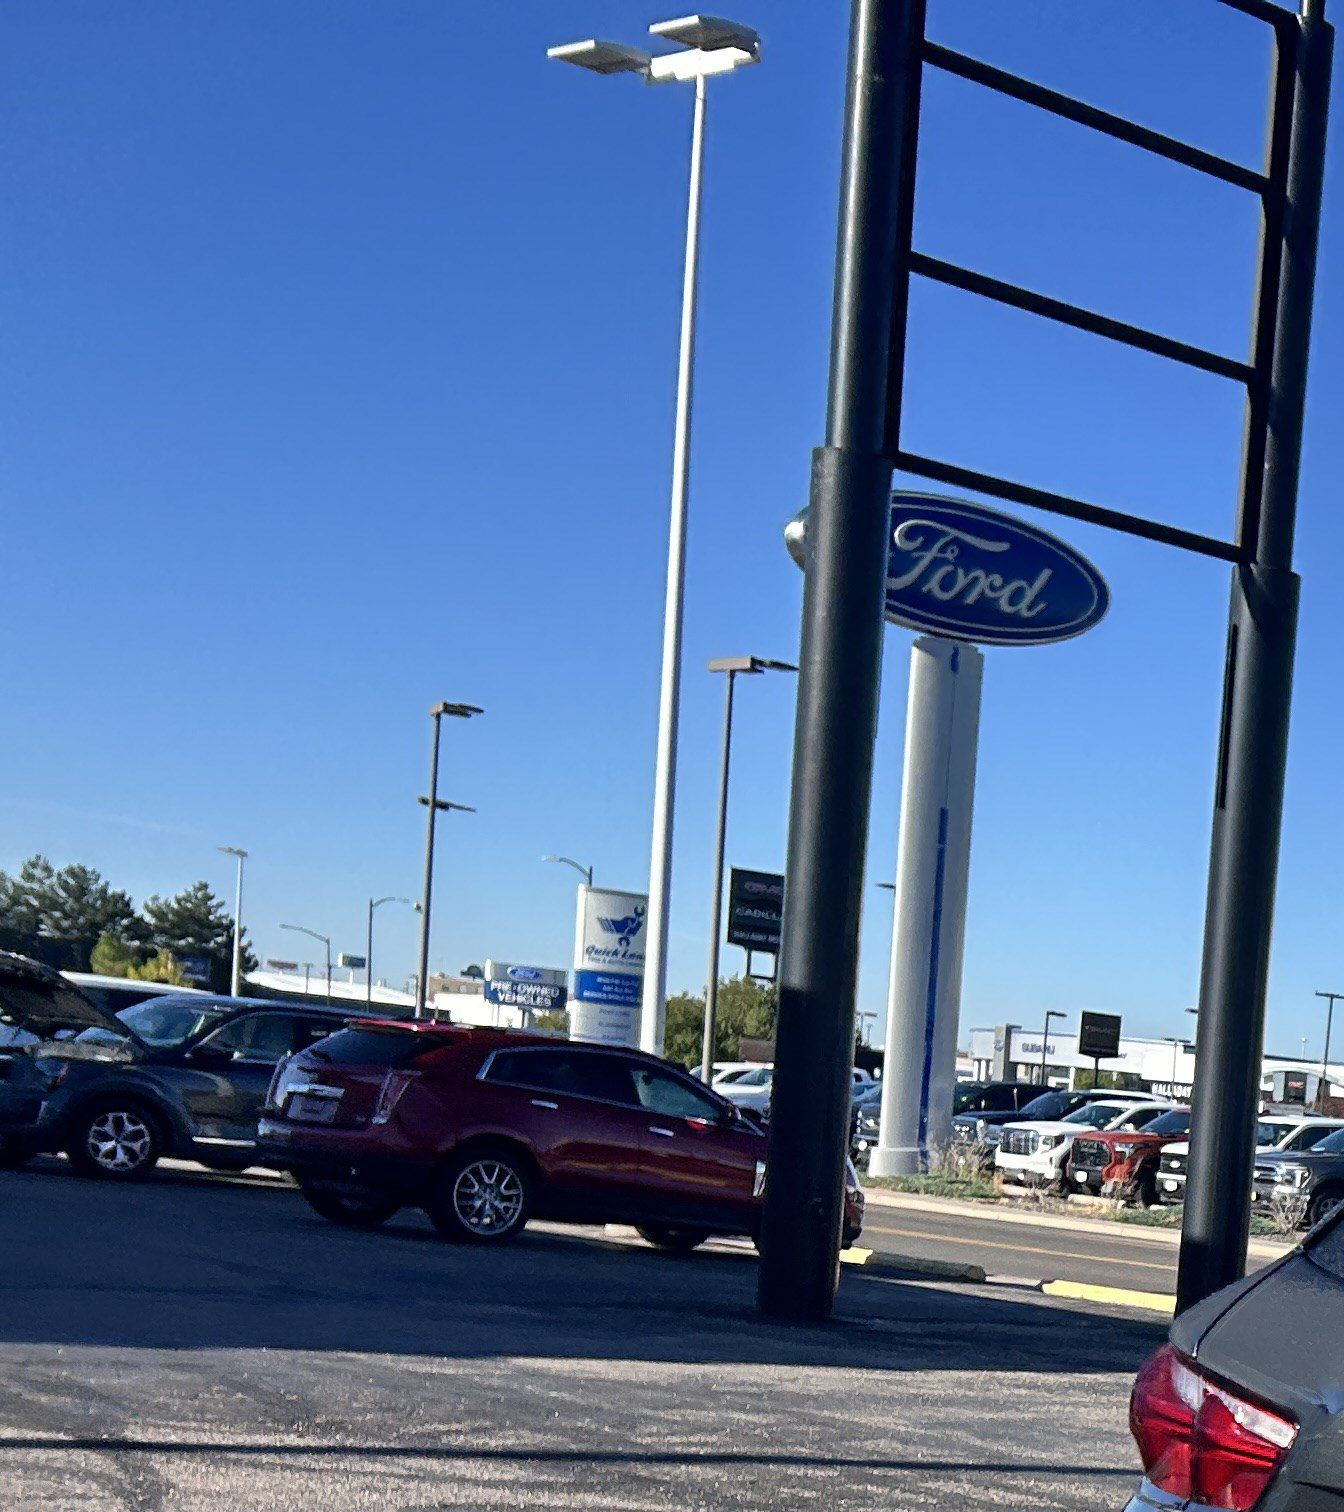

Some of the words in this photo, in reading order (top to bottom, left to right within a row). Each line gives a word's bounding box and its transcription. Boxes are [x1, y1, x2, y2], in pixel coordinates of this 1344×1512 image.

[887, 519, 1052, 618] Ford
[586, 944, 619, 958] Quick
[621, 949, 645, 960] Lan
[498, 992, 551, 1007] VEHICLES
